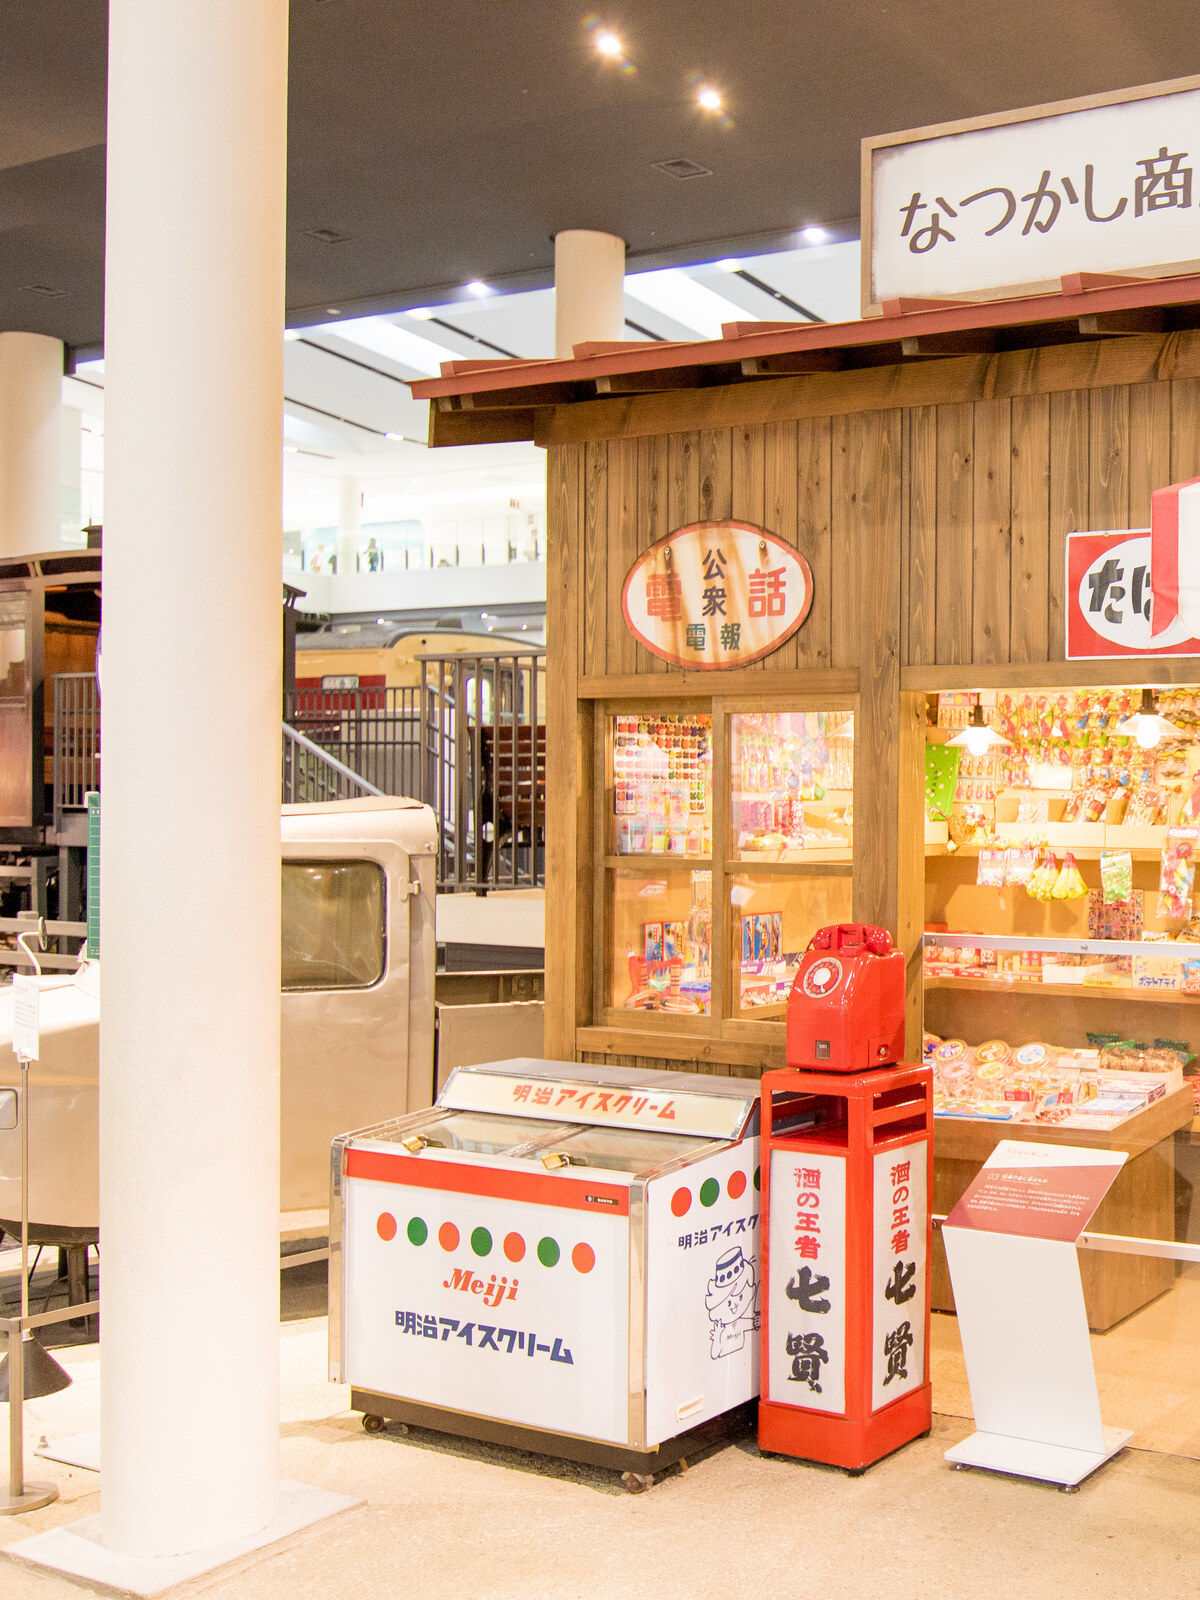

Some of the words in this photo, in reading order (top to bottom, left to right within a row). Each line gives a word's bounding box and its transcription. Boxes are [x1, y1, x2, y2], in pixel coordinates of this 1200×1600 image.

[702, 549, 727, 616] 公衆
[686, 623, 741, 651] 電報
[512, 1083, 677, 1120] 明治アイスクリーム
[793, 1167, 822, 1261] 酒の王者
[889, 1159, 912, 1255] 酒の王者
[443, 1268, 519, 1308] Meiji
[394, 1309, 575, 1366] 明治アイスクリーム
[785, 1264, 832, 1394] 七賢
[882, 1259, 917, 1388] 七賢
